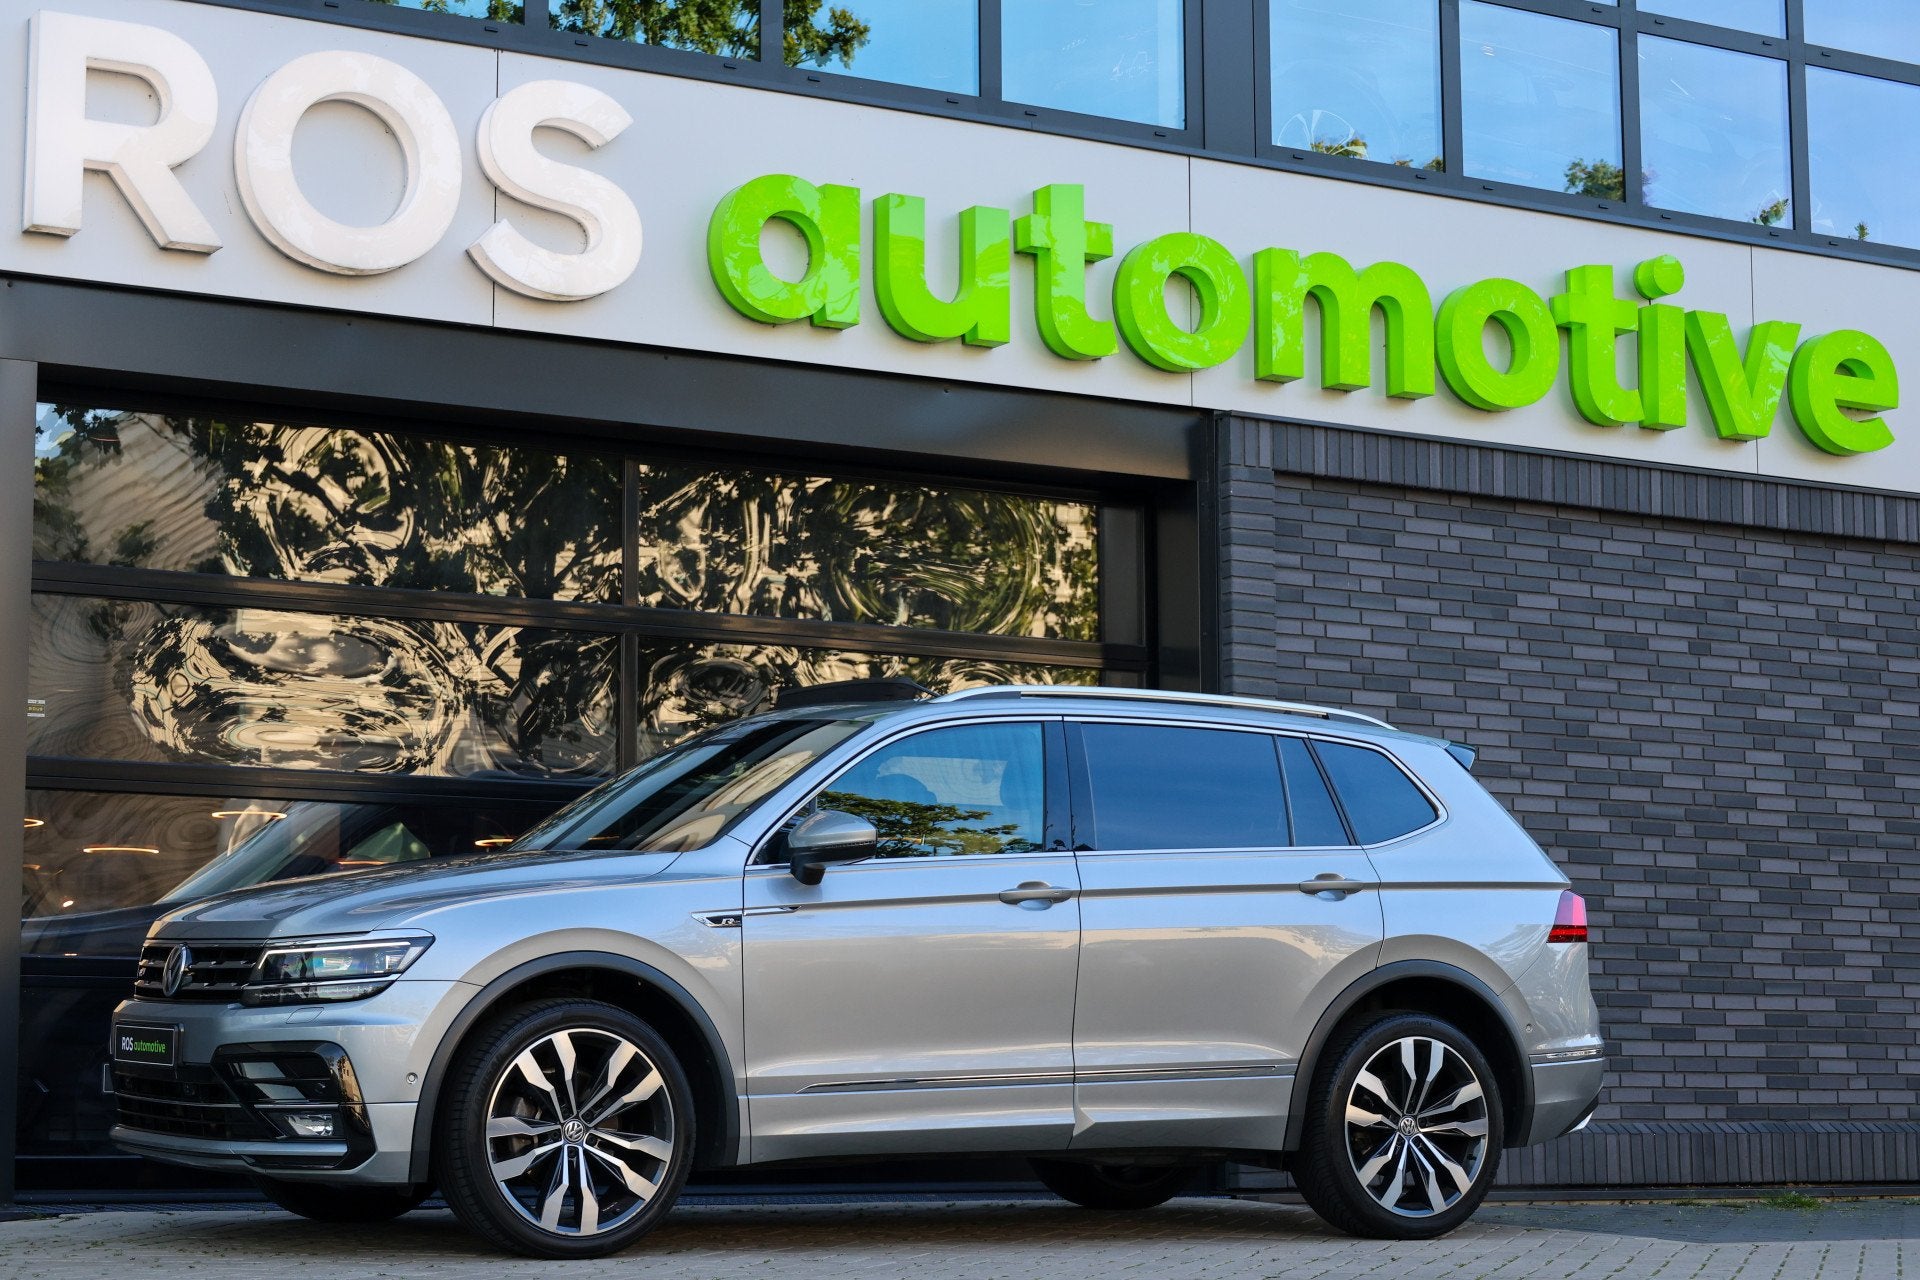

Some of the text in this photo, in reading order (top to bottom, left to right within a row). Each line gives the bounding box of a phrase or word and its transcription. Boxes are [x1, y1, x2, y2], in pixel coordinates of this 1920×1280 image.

[22, 9, 1899, 456] ROS automotive
[121, 1036, 166, 1053] ROS automotive
